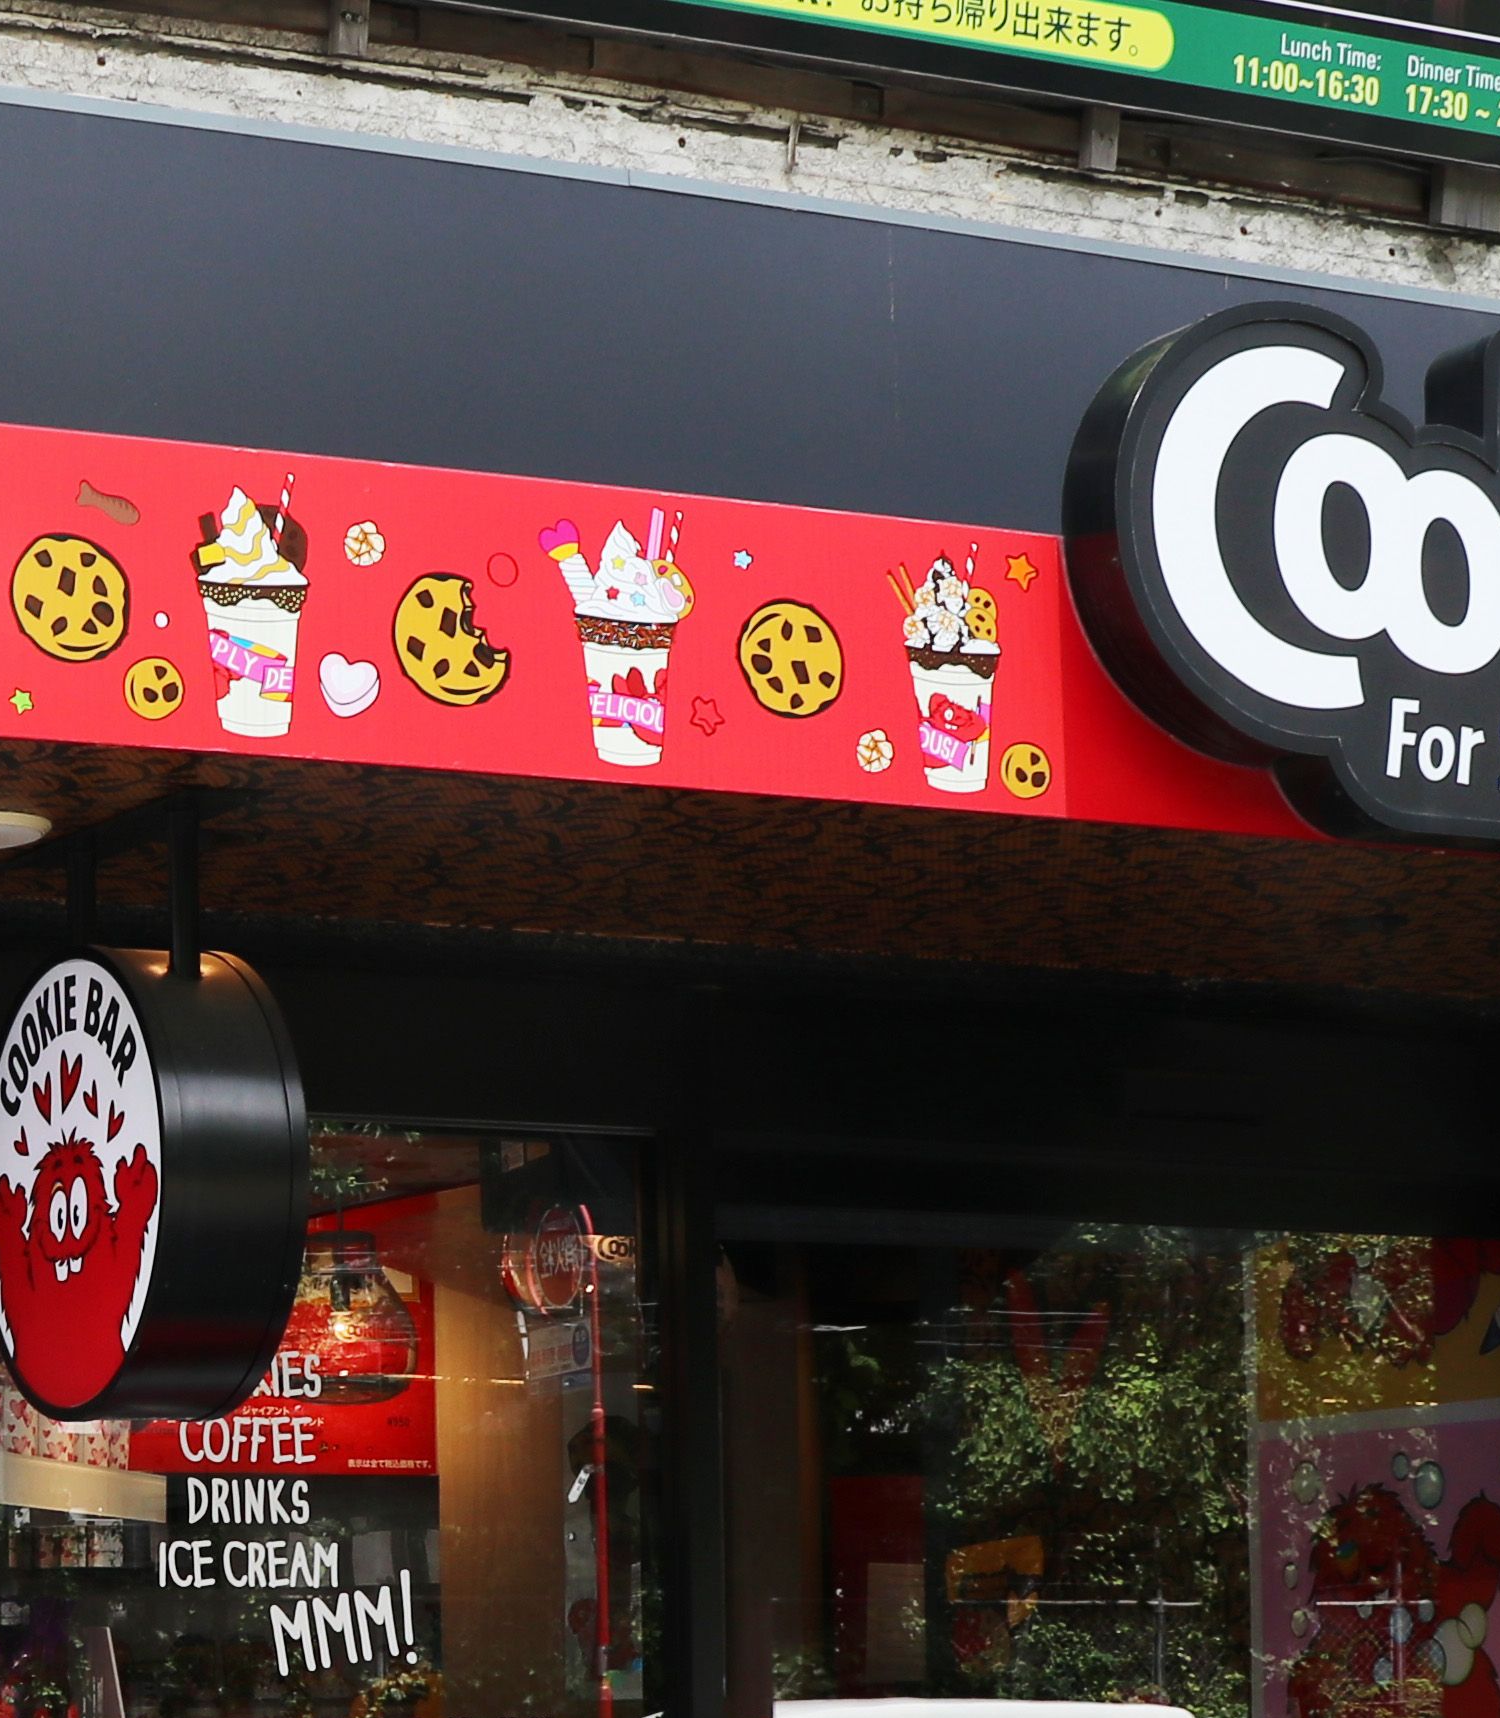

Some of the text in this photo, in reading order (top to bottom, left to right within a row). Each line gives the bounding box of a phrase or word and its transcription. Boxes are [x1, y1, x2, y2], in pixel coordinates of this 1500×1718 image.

[1281, 33, 1383, 71] Lunch Time:
[1407, 54, 1463, 87] Dinner
[1233, 54, 1380, 107] 11:00~16:30
[1404, 83, 1469, 122] 17:30
[212, 637, 259, 678] PLY
[589, 693, 665, 726] ELICIOU
[1386, 698, 1475, 787] For
[0, 974, 137, 1117] COOKIE BAR
[179, 1415, 317, 1463] COFFEE
[186, 1478, 311, 1526] DRINKS
[158, 1540, 340, 1589] ICE CREAM
[269, 1569, 419, 1678] MMM!
